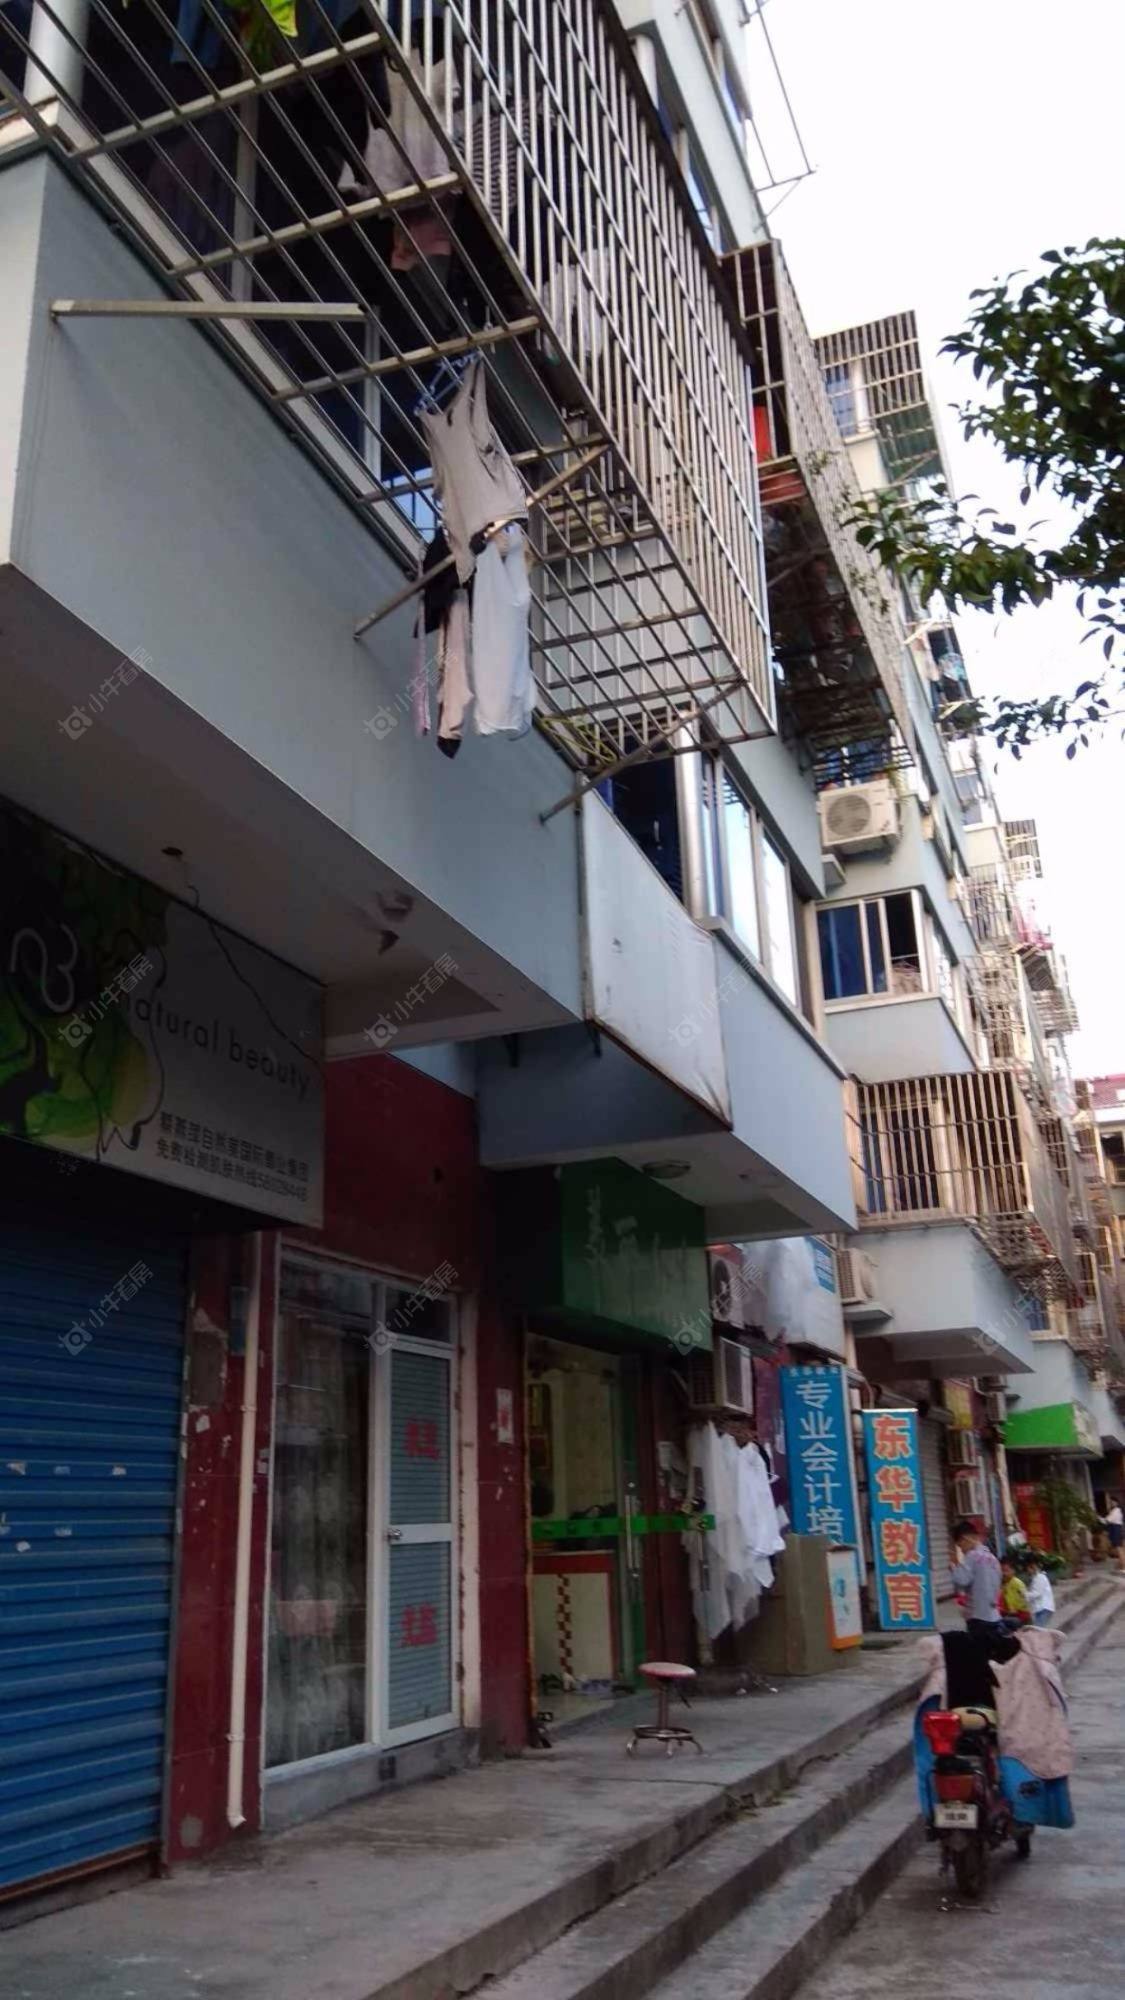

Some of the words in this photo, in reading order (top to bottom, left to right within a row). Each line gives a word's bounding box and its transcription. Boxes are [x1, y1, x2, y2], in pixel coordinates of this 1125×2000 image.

[128, 997, 218, 1051] atural
[229, 1027, 311, 1101] beauty
[872, 1414, 926, 1622] 东华教育
